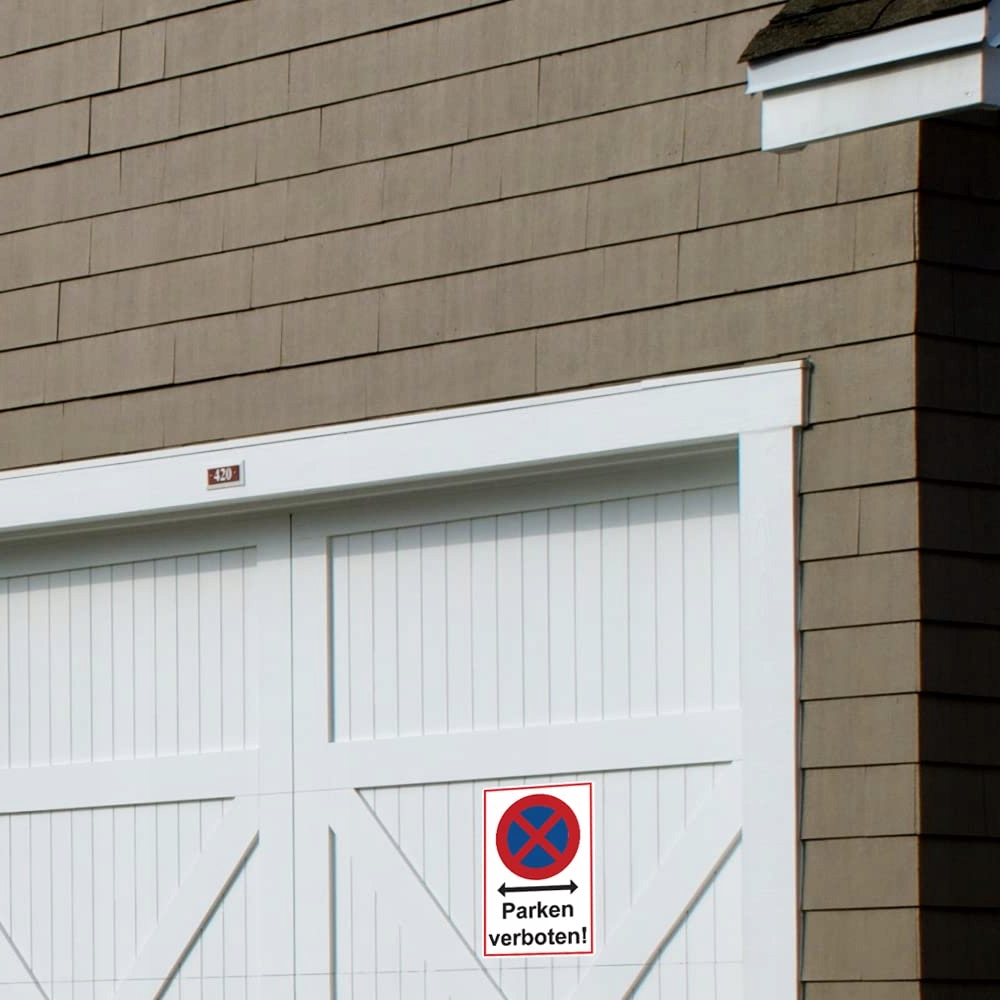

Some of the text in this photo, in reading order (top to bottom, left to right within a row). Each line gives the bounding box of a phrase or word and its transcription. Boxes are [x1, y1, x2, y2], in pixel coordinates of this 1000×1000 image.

[213, 467, 233, 482] 420
[502, 901, 574, 919] Parken
[488, 927, 587, 946] verboten!
